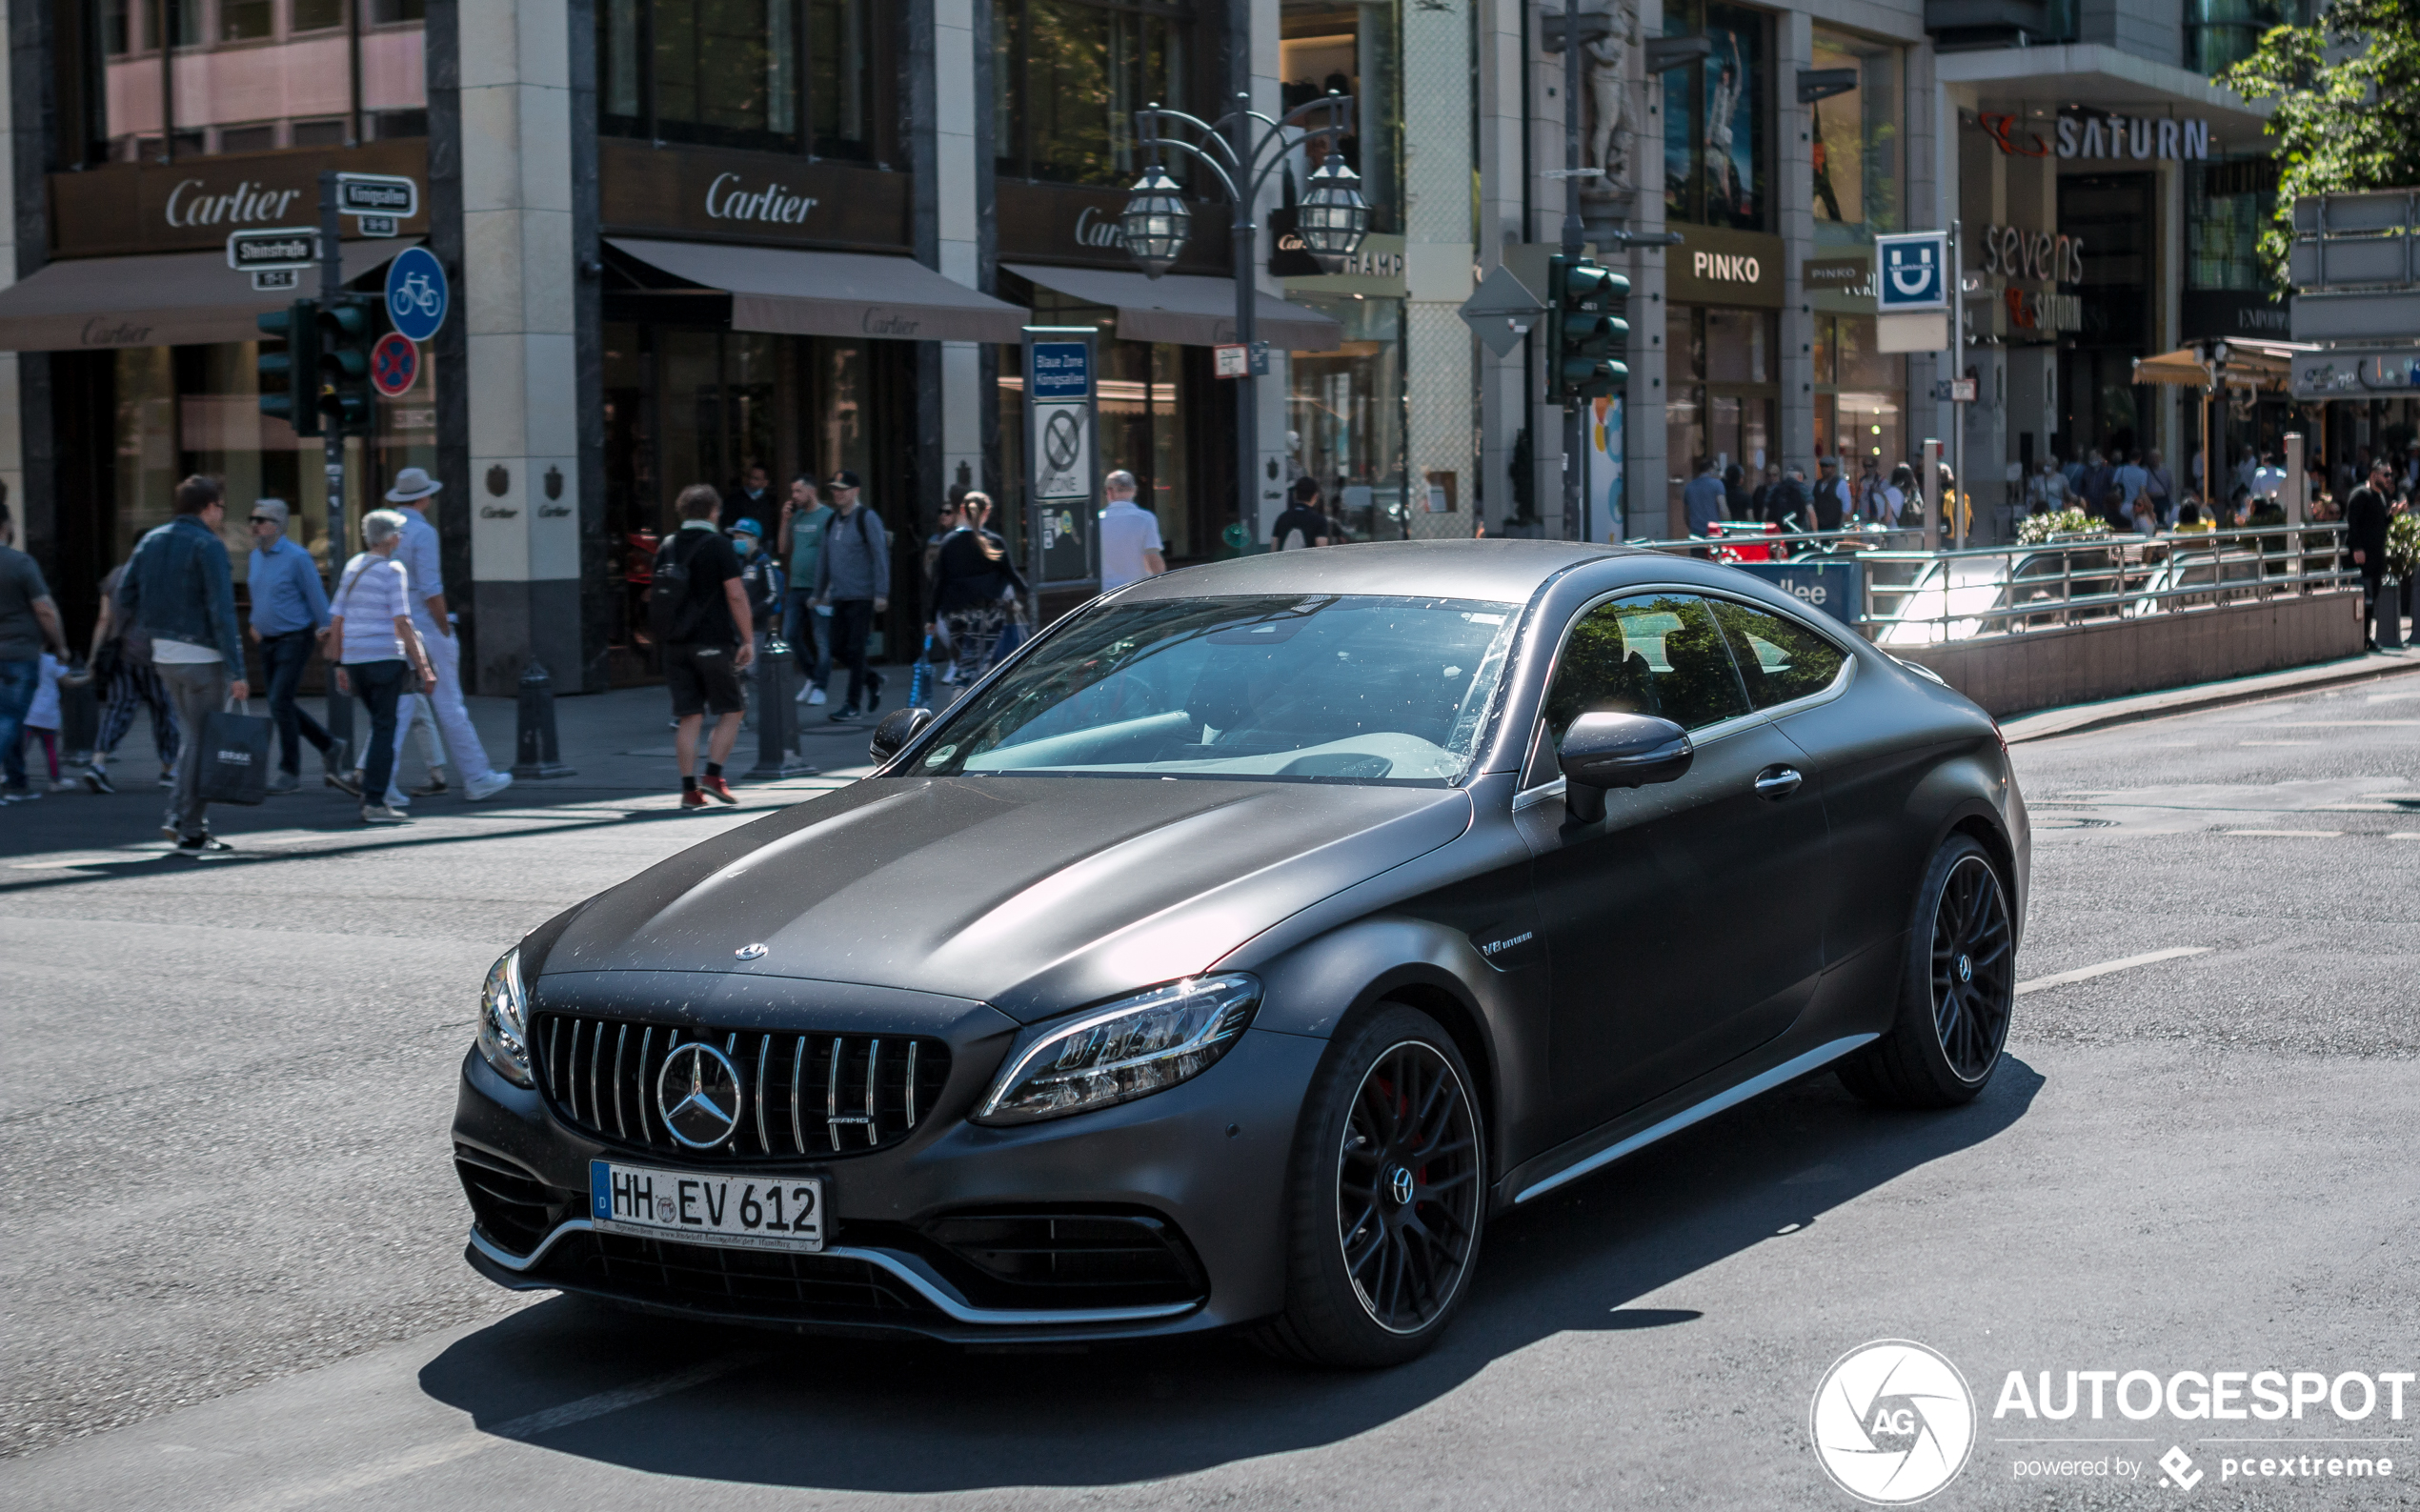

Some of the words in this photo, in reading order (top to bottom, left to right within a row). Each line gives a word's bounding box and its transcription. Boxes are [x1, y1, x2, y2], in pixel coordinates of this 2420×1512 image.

[2056, 115, 2208, 161] SATURN
[165, 178, 301, 229] Cartier
[705, 172, 817, 224] Cartier
[240, 240, 308, 259] Steinstraße
[1342, 252, 1402, 277] HAMP
[1694, 251, 1761, 284] PINKO
[1812, 268, 1856, 279] PINKO
[862, 307, 919, 335] Cartier
[2035, 292, 2083, 333] SATURN
[81, 315, 152, 345] Cartier
[1037, 354, 1061, 368] Blaue
[1062, 354, 1084, 368] Zone
[1036, 373, 1085, 389] Königsallee
[1049, 477, 1077, 492] ZONE
[480, 506, 518, 519] Cartier
[537, 505, 572, 517] Cartier
[1780, 578, 1827, 605] llee
[1482, 939, 1502, 957] V8
[1502, 931, 1533, 950] BITURBO
[598, 1196, 607, 1210] D
[612, 1171, 654, 1220] HH
[678, 1179, 727, 1227] EV
[739, 1183, 817, 1233] 612
